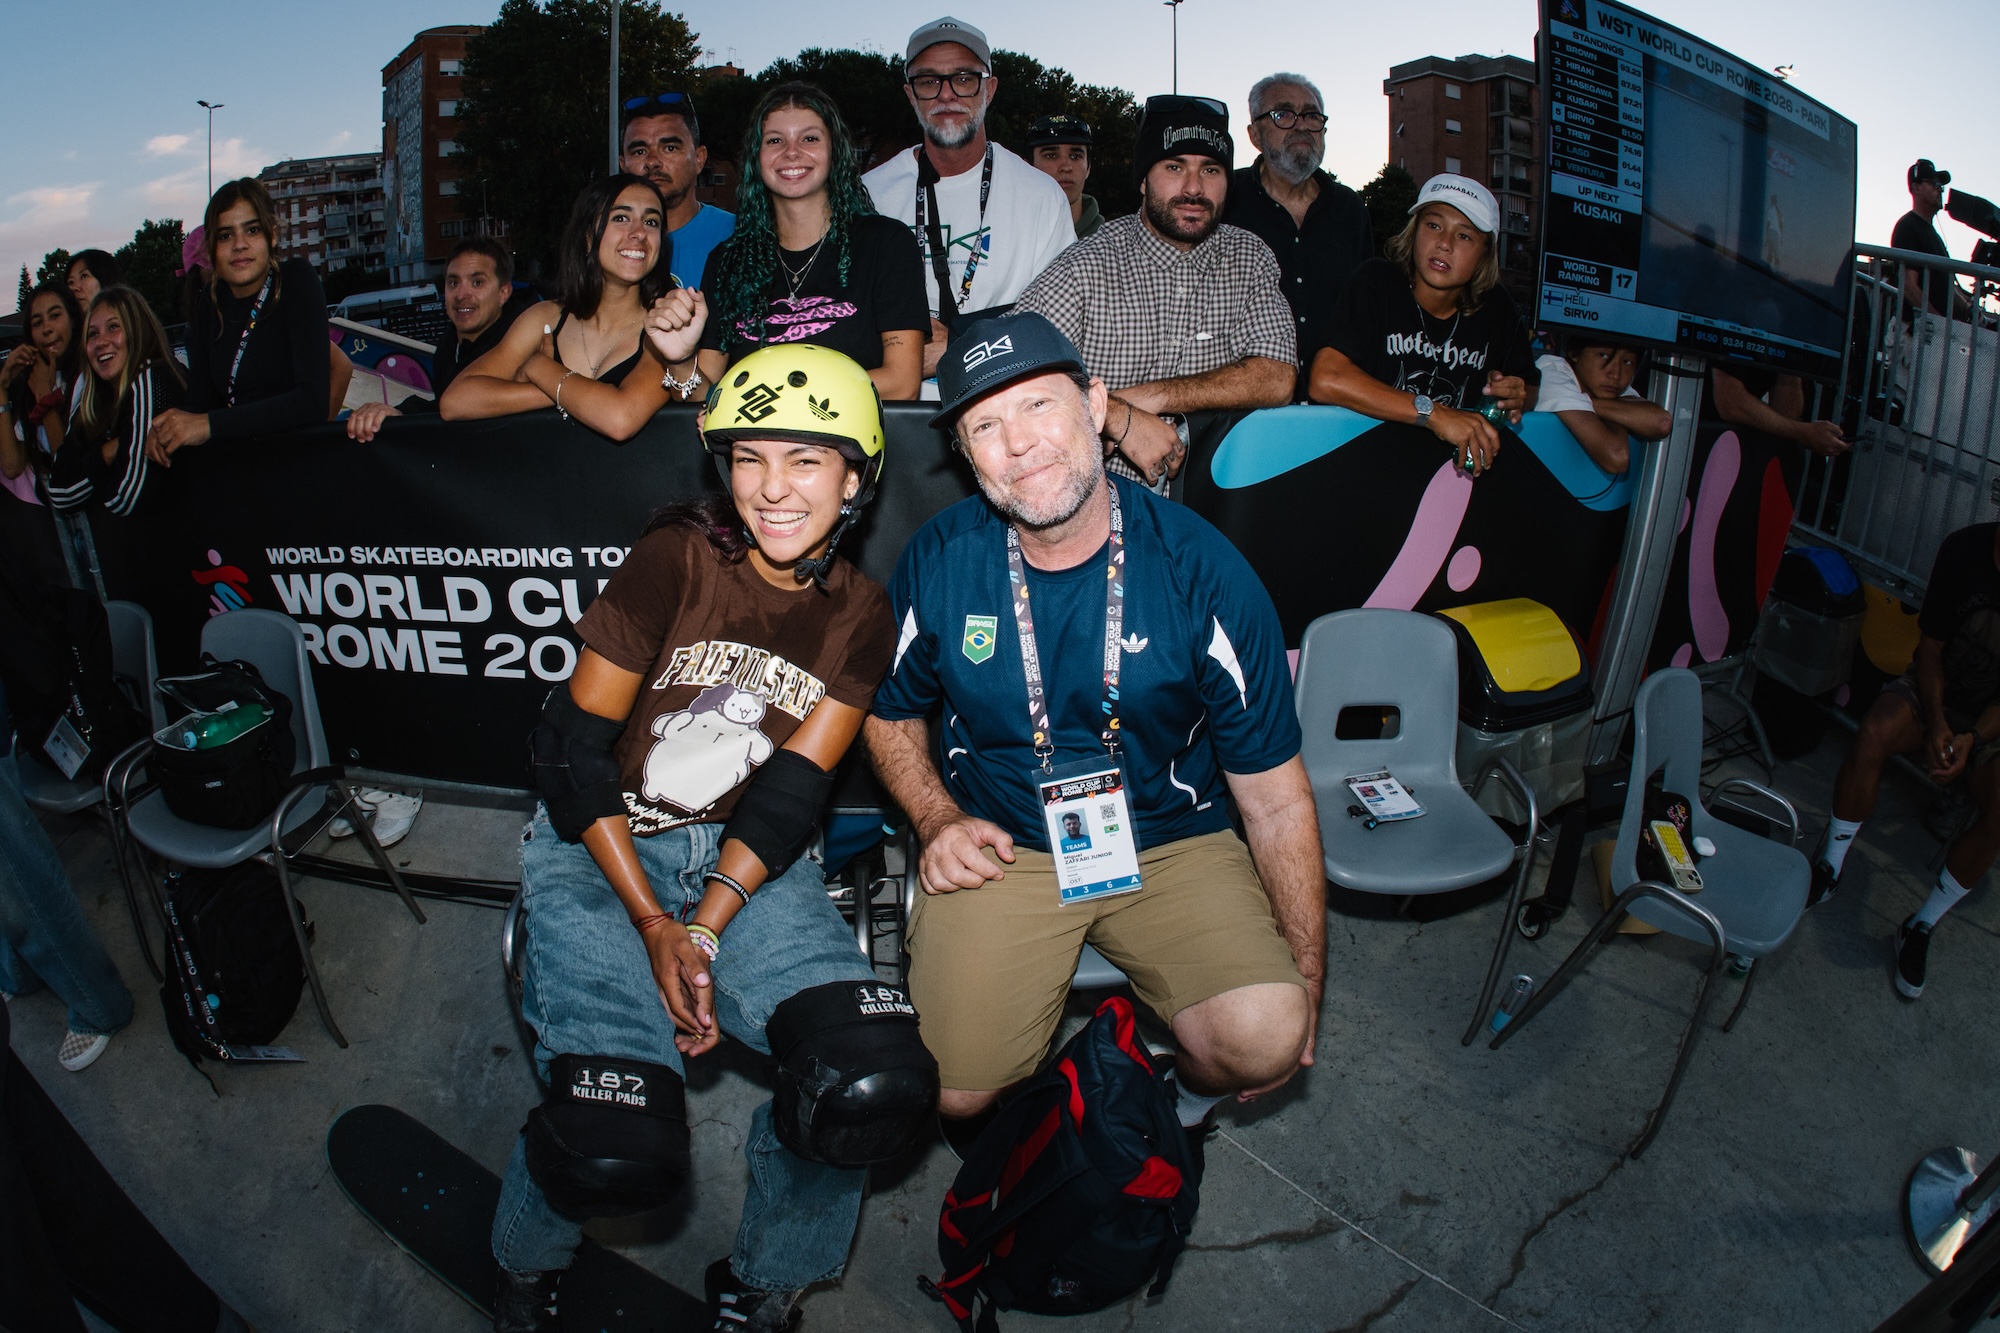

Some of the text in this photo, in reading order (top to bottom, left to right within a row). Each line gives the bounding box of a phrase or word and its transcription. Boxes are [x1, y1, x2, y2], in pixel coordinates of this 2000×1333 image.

[1572, 31, 1624, 56] STANDINGS
[1565, 44, 1597, 61] BROWN
[1566, 61, 1595, 76] HIRAKI
[1597, 10, 1633, 38] WST
[1637, 26, 1692, 63] WORLD
[1695, 53, 1723, 76] CUP
[1726, 67, 1762, 97] ROME
[1764, 88, 1793, 113] 2026
[1801, 106, 1828, 133] PARK
[1566, 77, 1613, 99] HASEGAWA
[1566, 94, 1598, 110] KUSAKI
[1566, 111, 1595, 126] SIRVIO
[1566, 127, 1591, 141] TREW
[1566, 145, 1590, 158] LASO
[1566, 162, 1605, 179] VENTURA
[1578, 185, 1620, 204] UP NEXT
[1573, 201, 1622, 224] KUSAKI
[1563, 261, 1597, 275] WORLD
[1558, 270, 1600, 286] RANKING
[1616, 273, 1632, 289] 17
[1565, 293, 1589, 307] HEILI
[1564, 306, 1599, 321] SIRVIO
[1681, 328, 1688, 337] 5
[1722, 336, 1744, 349] 93.24
[1746, 341, 1766, 354] 87.22
[266, 546, 632, 568] WORLD SKATEBOARDING TO
[271, 572, 492, 623] WORLD
[967, 619, 996, 628] BRASIL
[1114, 621, 1122, 643] 2026
[298, 622, 586, 682] ROME 20
[1020, 634, 1029, 660] ROME
[1026, 633, 1036, 663] WORLD
[1107, 621, 1116, 671] WORLD CUP
[1024, 661, 1033, 682] 2026
[1030, 664, 1039, 681] CUP
[1061, 783, 1086, 793] WORLD
[1086, 779, 1101, 788] CUP
[1062, 789, 1084, 797] ROME
[1065, 842, 1088, 851] TEAMS
[1064, 852, 1083, 860] Miguel
[1091, 851, 1113, 860] JUNIOR
[1131, 876, 1139, 884] A
[860, 987, 903, 1003] 187
[860, 1003, 896, 1015] KILLER
[580, 1069, 645, 1093] 187
[572, 1085, 647, 1107] KILLER PADS
